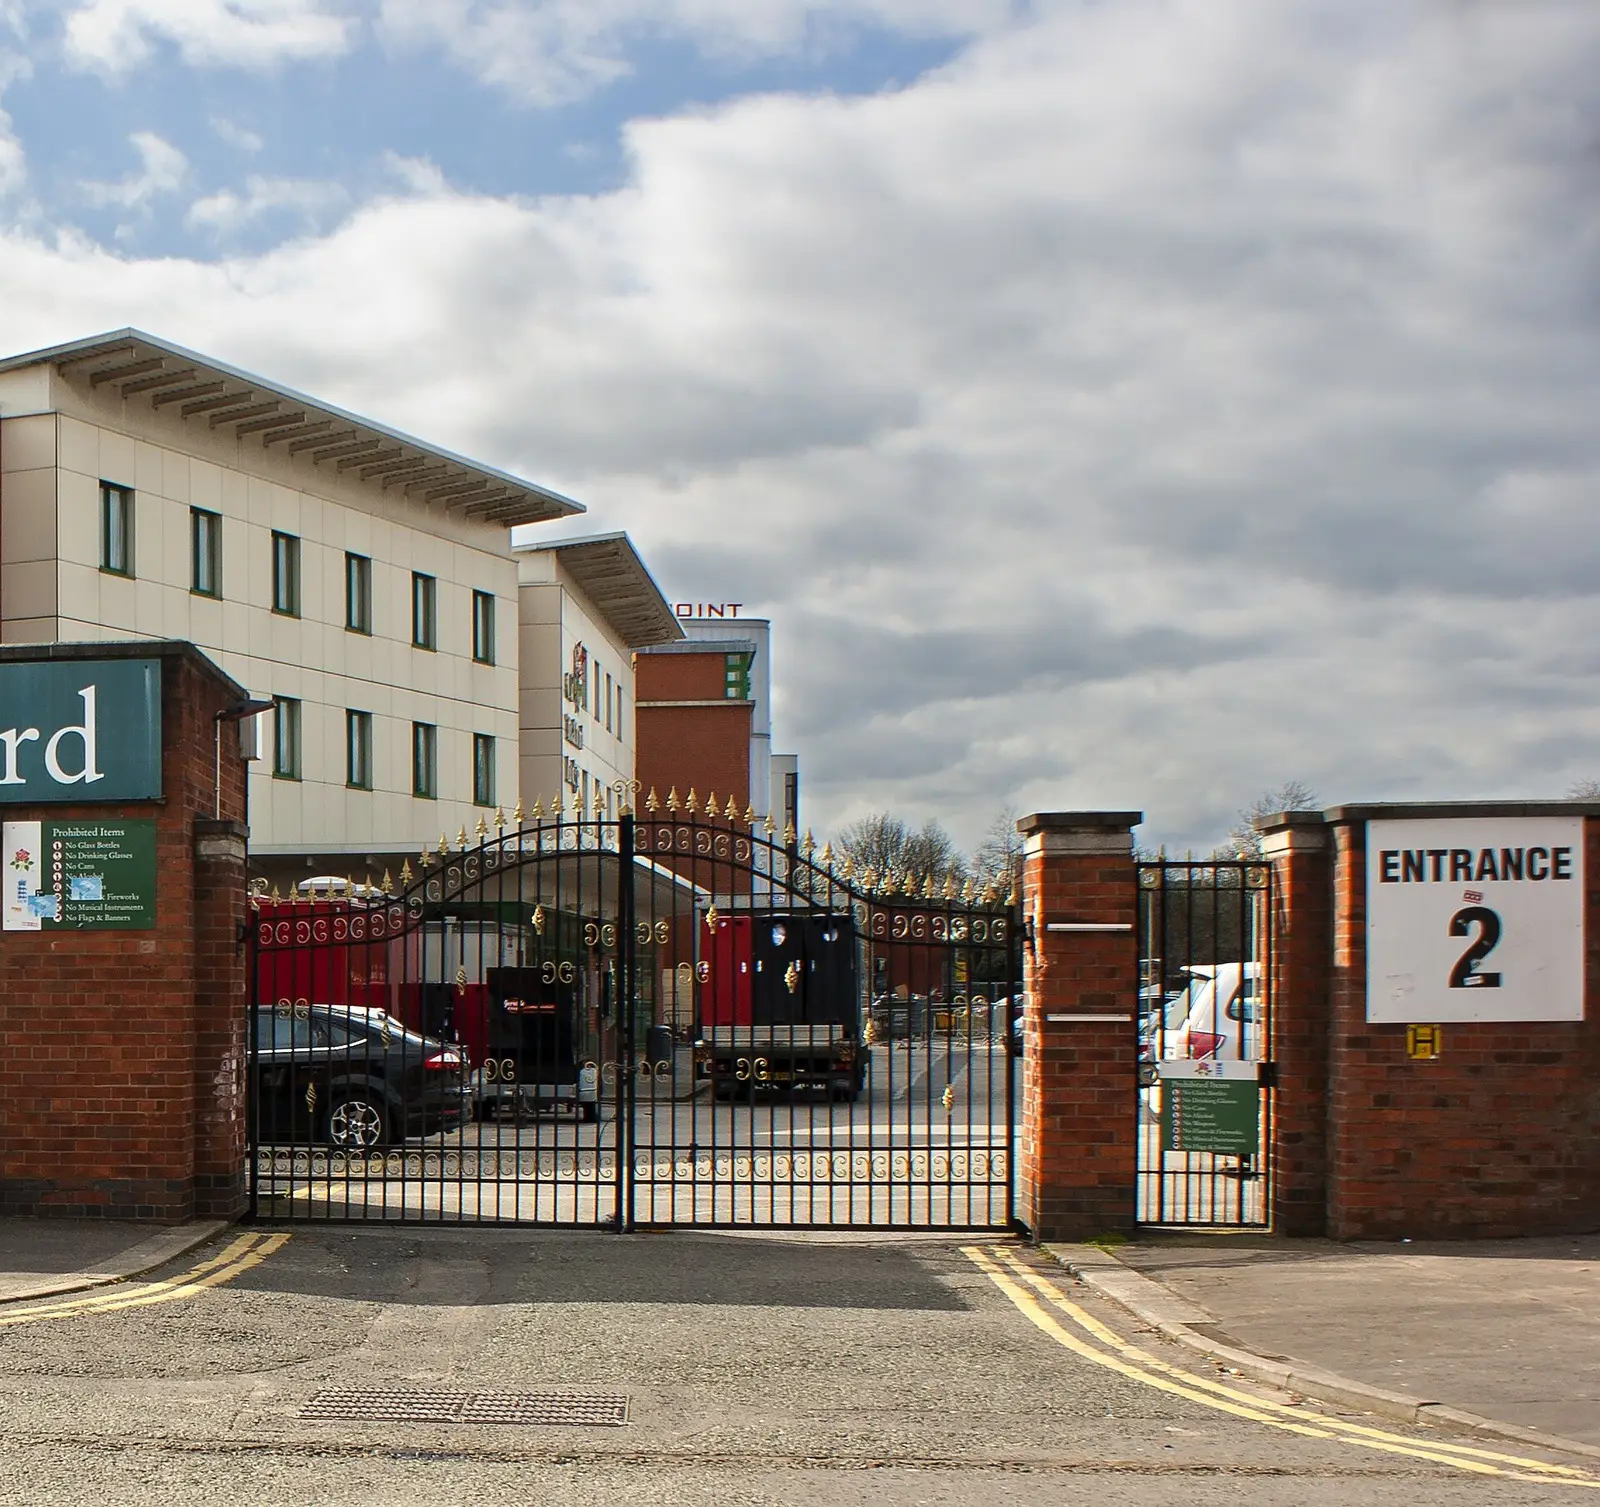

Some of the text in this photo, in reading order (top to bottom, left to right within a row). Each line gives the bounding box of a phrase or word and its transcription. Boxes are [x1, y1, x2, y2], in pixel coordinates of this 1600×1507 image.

[669, 604, 743, 618] OINT
[52, 827, 125, 837] Prohibited Items
[77, 841, 96, 849] Glass
[96, 841, 120, 849] Bottles
[77, 851, 108, 860] Drinking
[108, 851, 133, 859] Glasses
[65, 862, 95, 870] No Cans
[1379, 847, 1572, 883] ENTRANCE
[78, 903, 103, 911] Musical
[104, 903, 144, 911] Instruments
[78, 914, 95, 922] Flags
[1449, 906, 1501, 988] 2
